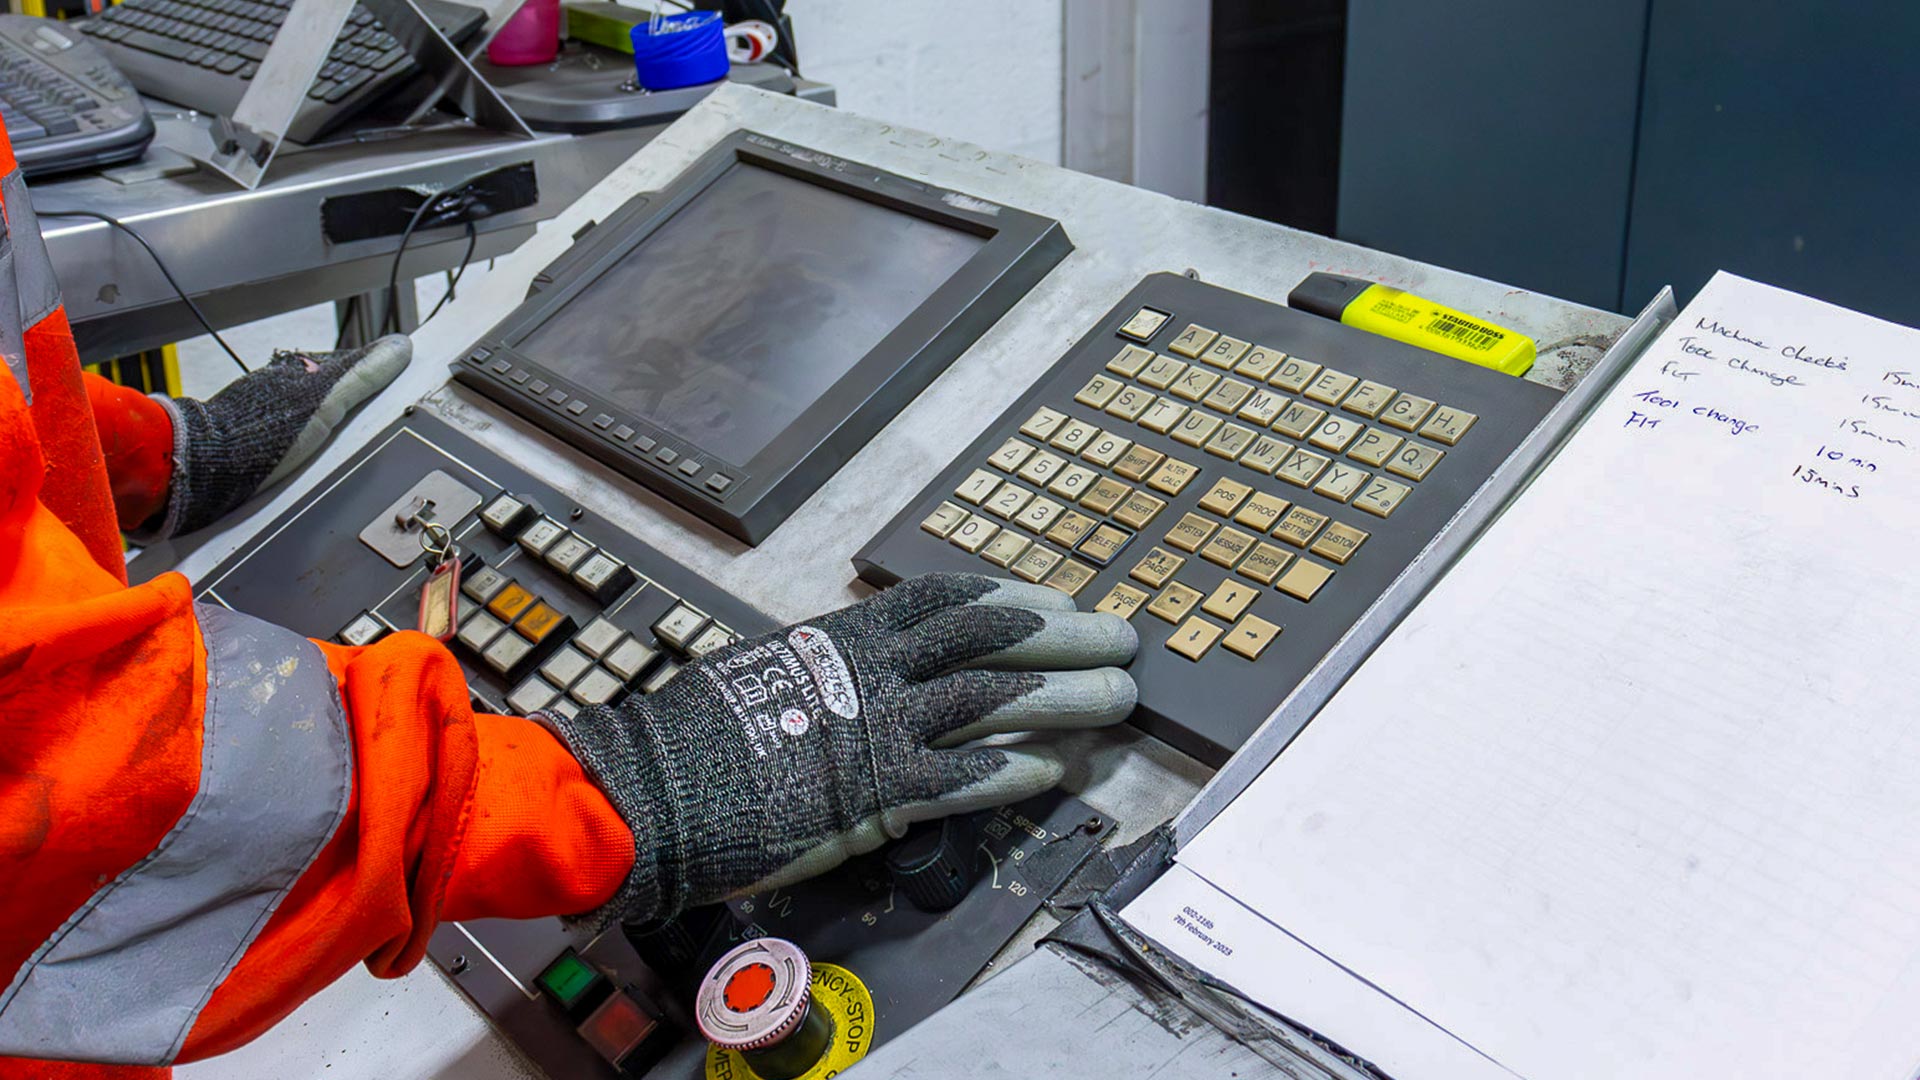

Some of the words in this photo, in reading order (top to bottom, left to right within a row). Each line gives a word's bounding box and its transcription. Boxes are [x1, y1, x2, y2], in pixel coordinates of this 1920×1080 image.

[1180, 330, 1196, 343] A
[1480, 326, 1505, 340] BOSS
[1214, 342, 1231, 355] B
[1120, 350, 1132, 362] I
[1248, 352, 1264, 366] C
[1151, 362, 1168, 374] J
[1282, 363, 1299, 377] D
[1182, 372, 1200, 386] K
[1316, 374, 1336, 390] E
[1086, 380, 1104, 394] R
[1216, 384, 1230, 398] L
[1354, 386, 1374, 399] F
[1118, 392, 1136, 406] S
[1250, 394, 1270, 410] M
[1154, 402, 1170, 416] T
[1392, 400, 1412, 414] G
[1284, 407, 1304, 422] N
[1432, 412, 1454, 428] H
[1034, 416, 1054, 428] 7
[1184, 416, 1201, 430] U
[1322, 422, 1340, 435] O
[1065, 428, 1083, 442] 8
[1220, 428, 1238, 442] V
[1360, 434, 1380, 448] P
[1692, 407, 1760, 436] change
[1815, 445, 1844, 461] 10
[1097, 440, 1114, 454] 9
[1252, 442, 1274, 458] W
[1004, 448, 1020, 461] 4
[1401, 448, 1420, 465] Q
[1034, 459, 1052, 474] 5
[1288, 454, 1310, 470] X
[1165, 463, 1188, 476] ALTER
[1330, 468, 1349, 484] Y
[973, 478, 986, 492] 1
[1064, 473, 1082, 487] 6
[1161, 475, 1182, 488] CALC
[1094, 486, 1120, 500] HELP
[1213, 488, 1237, 502] POS
[1366, 483, 1388, 500] Z
[999, 492, 1018, 508] 2
[1031, 506, 1049, 521] 3
[1126, 501, 1154, 516] INSERT
[1246, 502, 1278, 518] PROG
[961, 522, 978, 536] 0
[1062, 521, 1084, 535] CAN
[1176, 521, 1206, 538] SYSTEM
[1089, 534, 1120, 552] DELETE
[1322, 531, 1357, 548] CUSTOM
[1026, 554, 1048, 568] EOB
[1250, 552, 1280, 569] GRAPH
[1143, 560, 1170, 576] PAGE
[1111, 591, 1138, 608] PAGE
[802, 686, 823, 720] LITE
[1012, 814, 1047, 840] SPEED
[1008, 846, 1025, 860] 110
[1008, 881, 1028, 896] 120
[740, 899, 755, 915] 50
[1184, 922, 1215, 946] February
